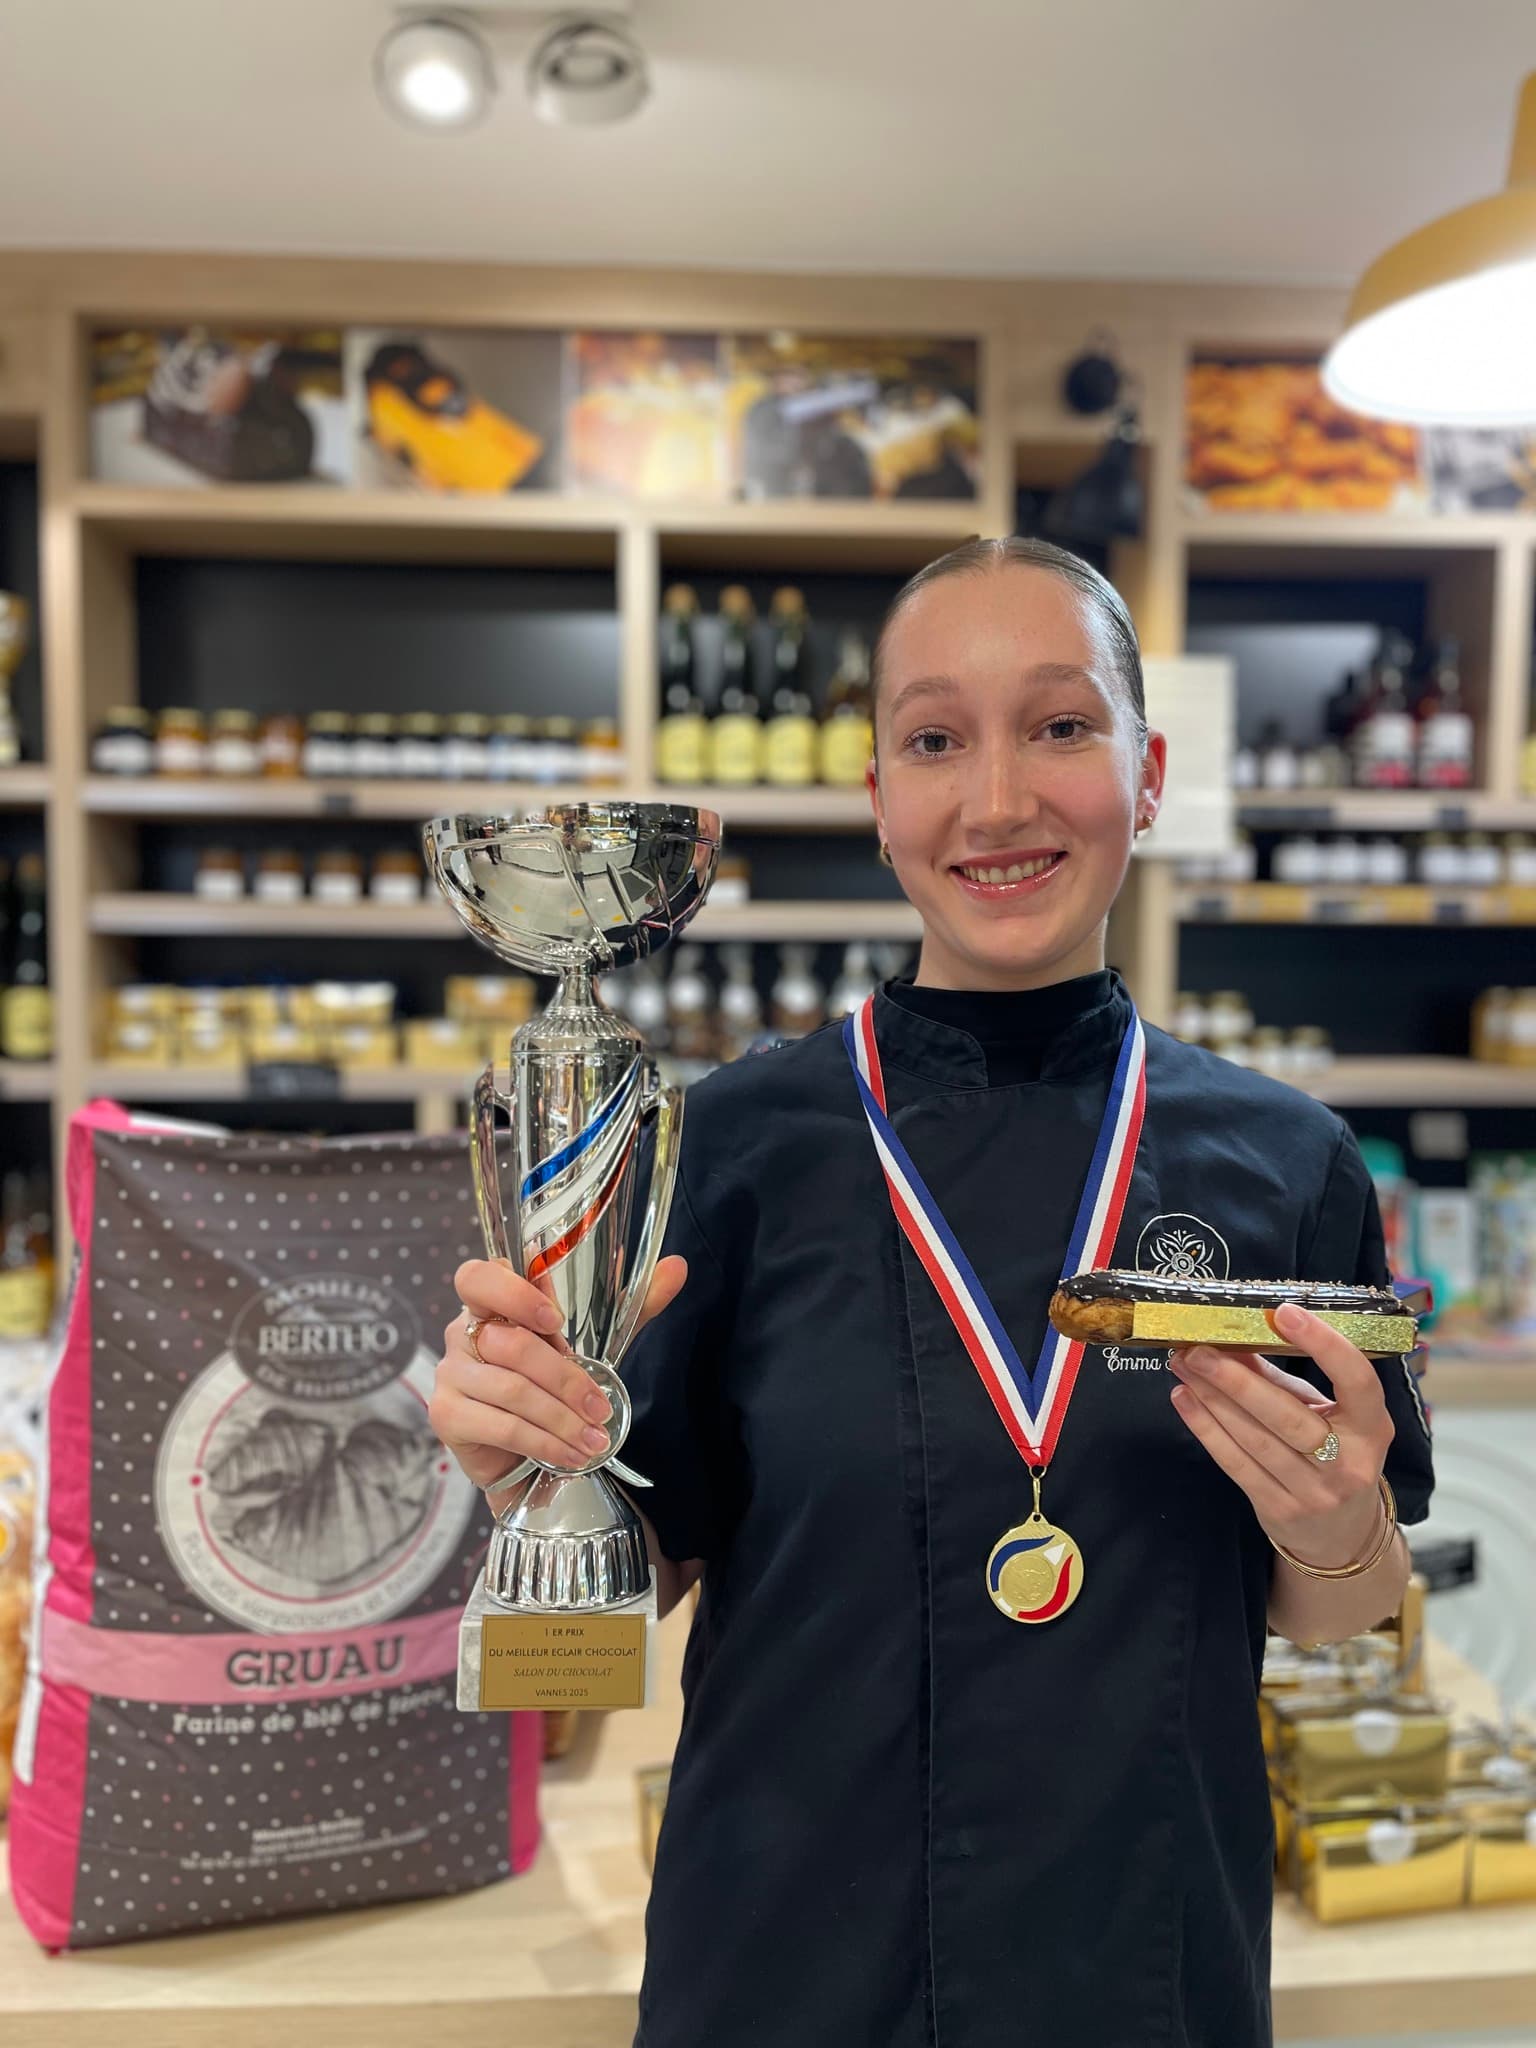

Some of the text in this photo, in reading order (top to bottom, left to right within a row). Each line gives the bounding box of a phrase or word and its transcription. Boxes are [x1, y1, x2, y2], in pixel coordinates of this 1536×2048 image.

[1102, 1346, 1162, 1373] Emma
[552, 1627, 563, 1637] ER
[565, 1627, 585, 1637] PRIX
[488, 1647, 638, 1657] DU MEILLEUR ECLAIR CHOCOLAT
[226, 1635, 405, 1688] GRUAU
[513, 1667, 613, 1677] SALON DU CHOCOLAT
[535, 1688, 589, 1697] VANNES 2025
[173, 1712, 256, 1735] Farine
[261, 1711, 296, 1734] de
